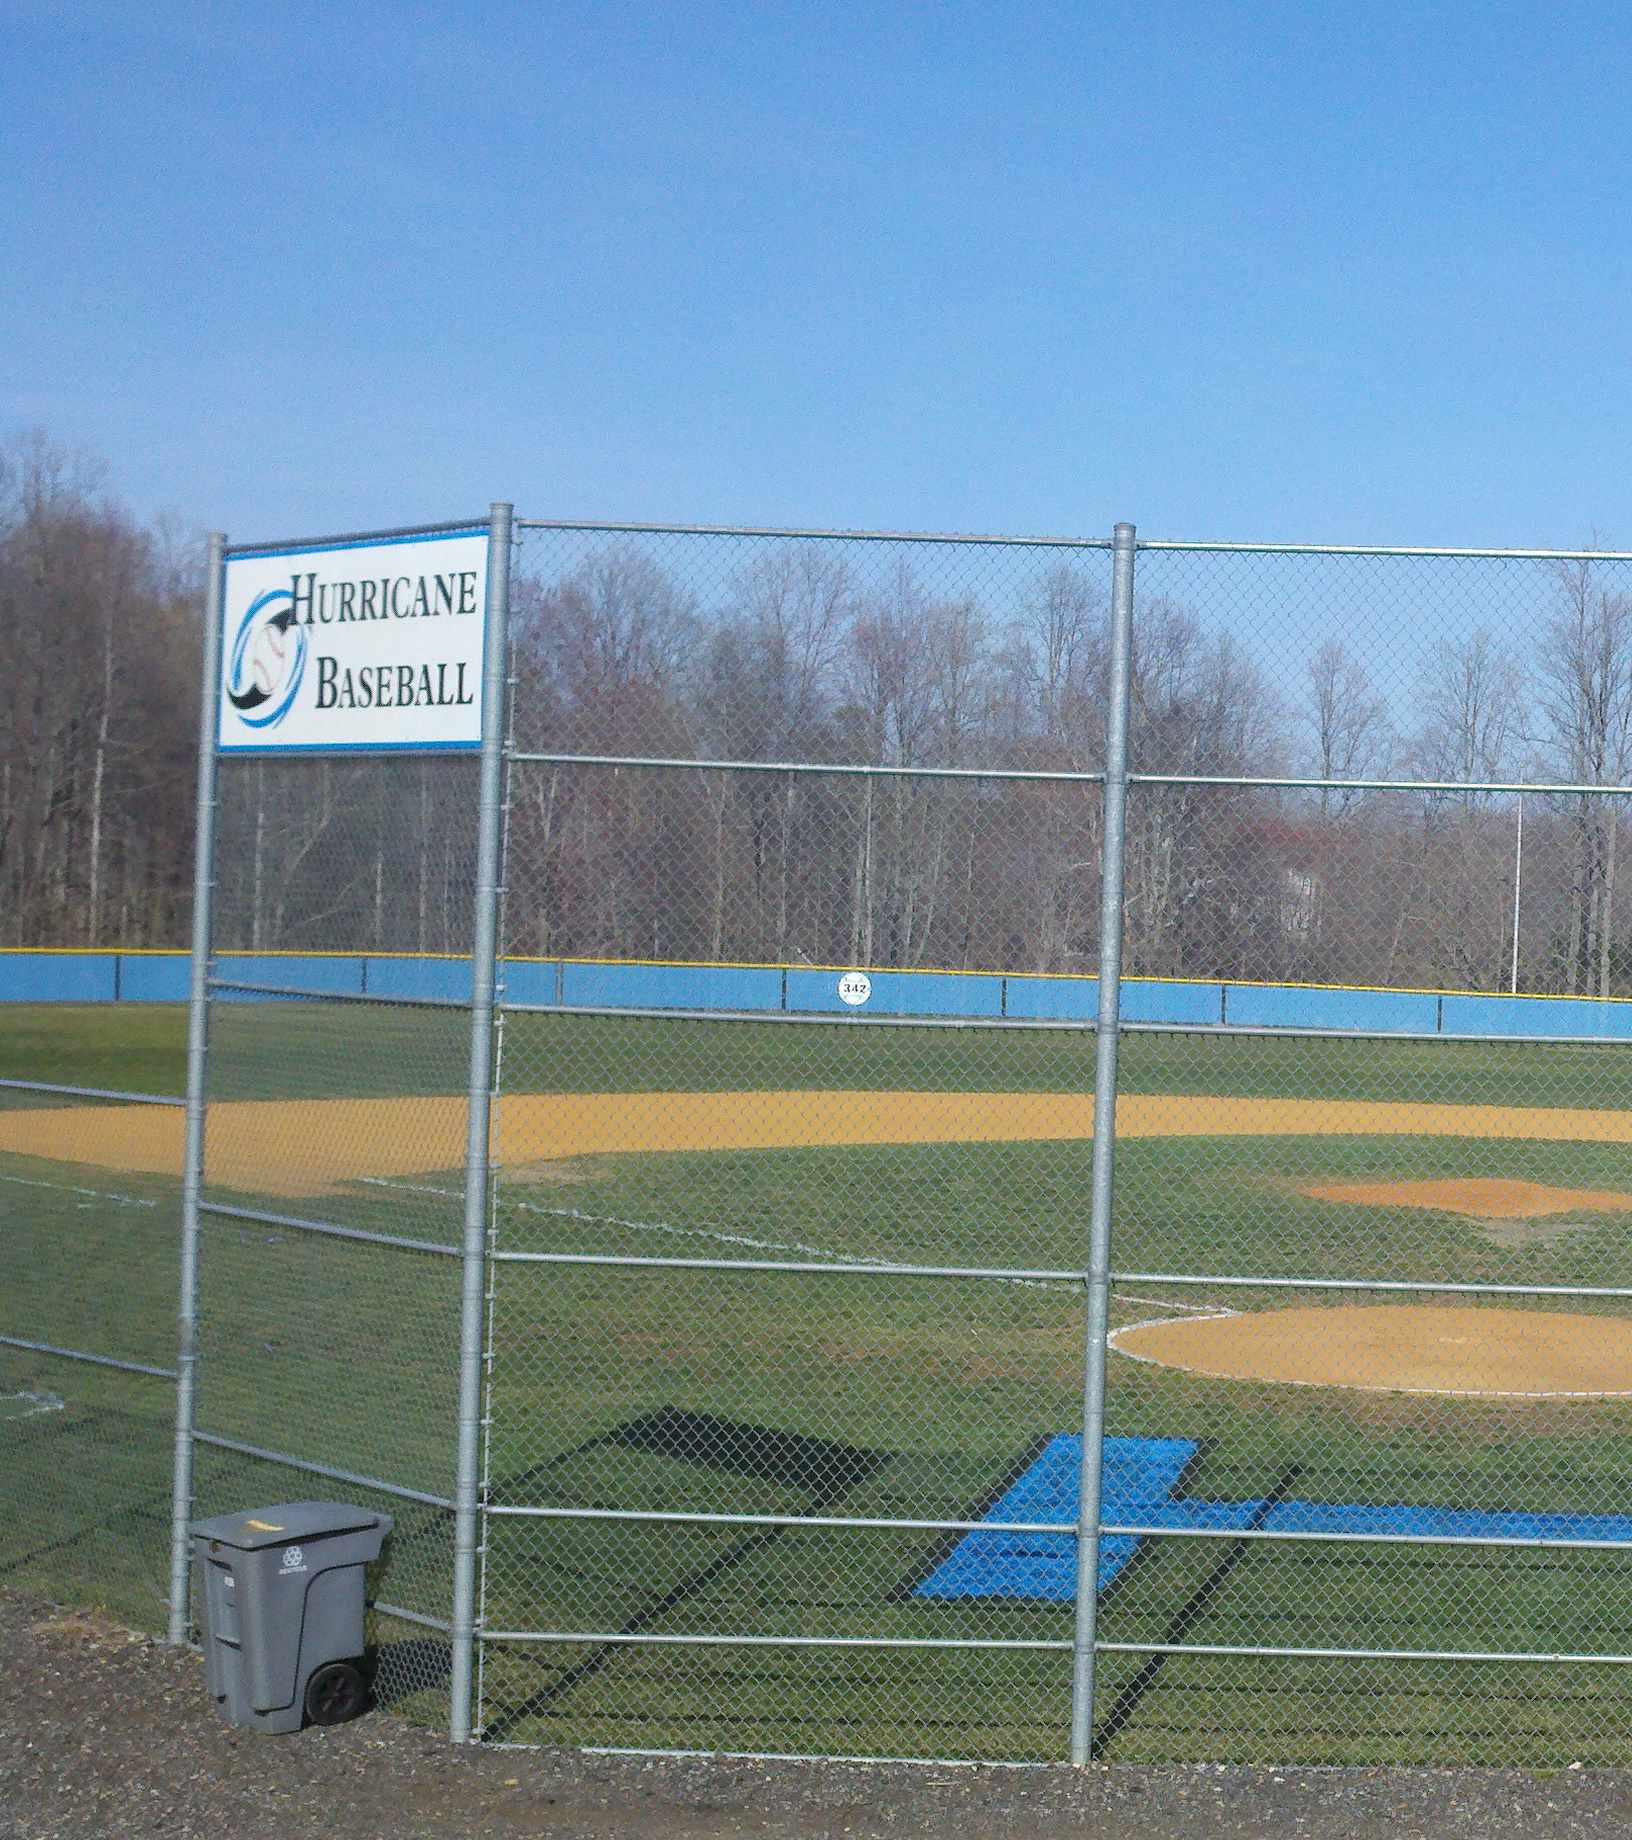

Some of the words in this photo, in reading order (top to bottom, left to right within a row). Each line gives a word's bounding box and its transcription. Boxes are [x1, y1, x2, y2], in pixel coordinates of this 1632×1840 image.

[289, 571, 477, 626] HURRICANE
[315, 655, 474, 709] BASEBALL
[843, 983, 867, 993] 342
